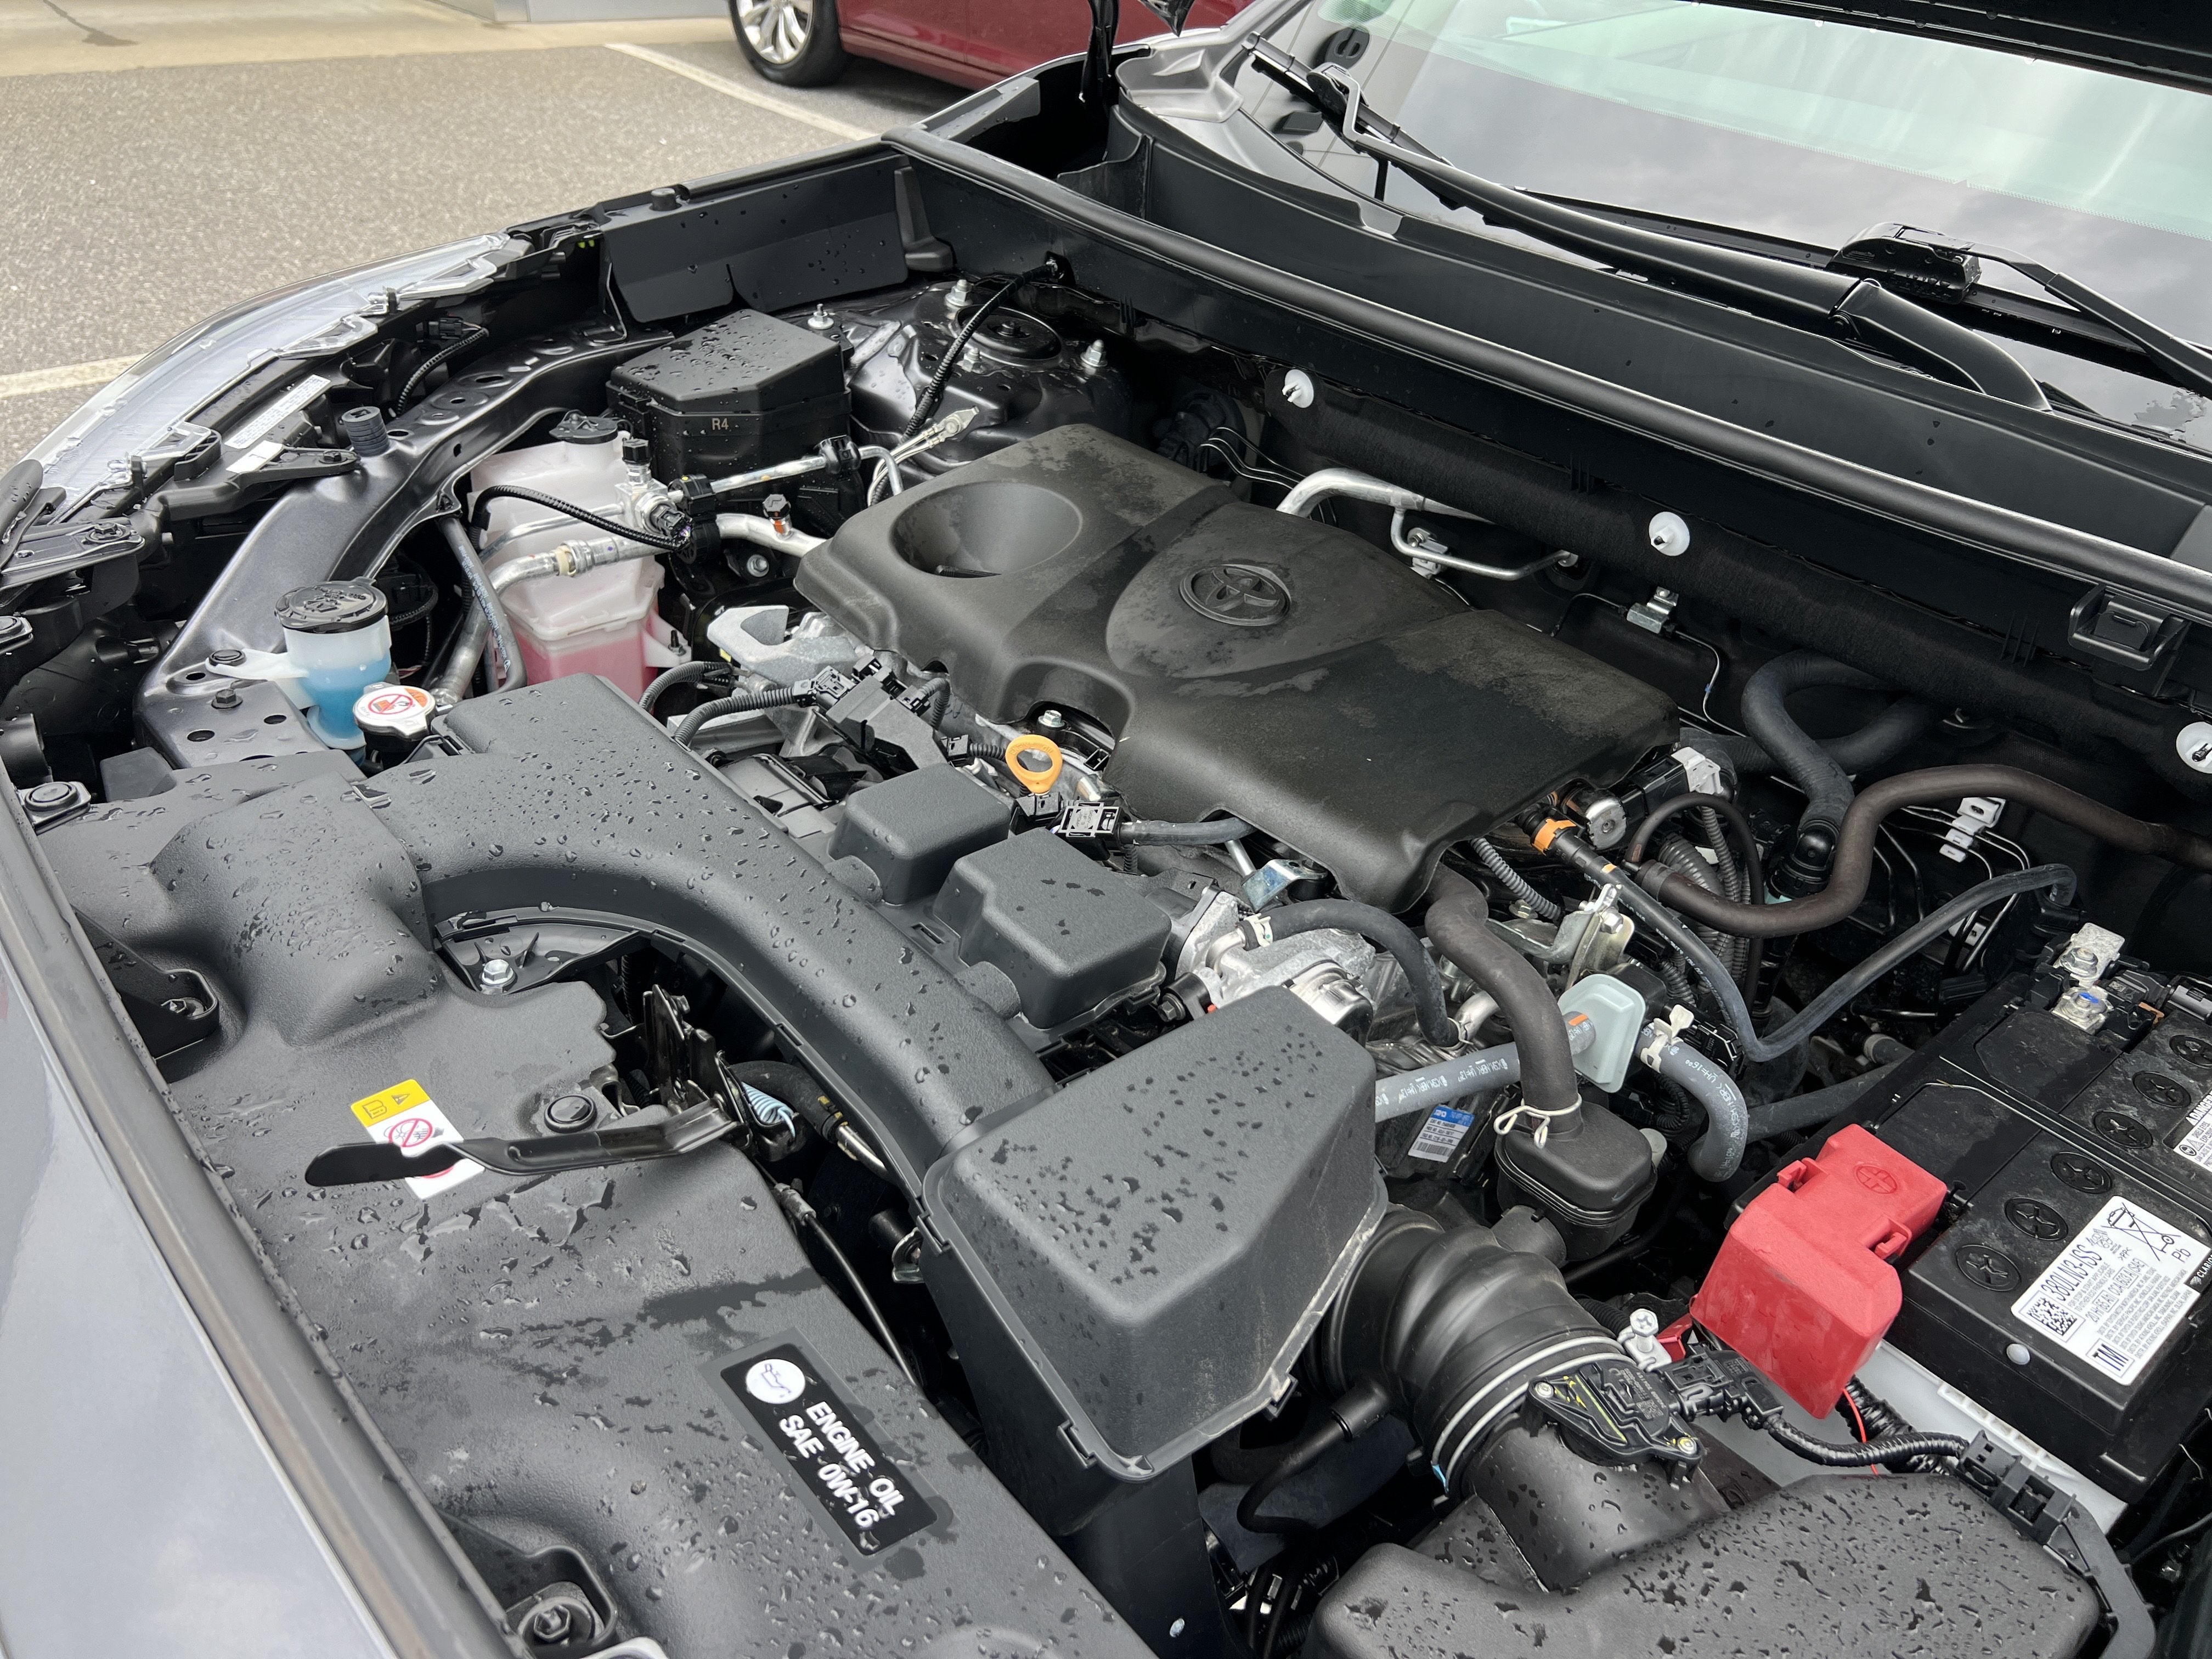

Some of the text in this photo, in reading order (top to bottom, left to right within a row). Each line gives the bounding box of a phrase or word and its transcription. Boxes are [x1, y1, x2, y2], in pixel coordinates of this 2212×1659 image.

[712, 417, 729, 430] R4
[2170, 1245, 2192, 1263] Pb
[2039, 1242, 2104, 1303] 380LN3-ISS
[2121, 1268, 2136, 1278] A
[2196, 1254, 2212, 1278] CLARIO
[2114, 1272, 2133, 1286] 603
[2106, 1280, 2126, 1296] CCA
[2094, 1298, 2111, 1311] 65
[2100, 1291, 2117, 1305] Ah
[2084, 1310, 2101, 1323] 20
[2091, 1341, 2130, 1374] TM
[806, 1401, 905, 1518] ENGINE OIL
[778, 1414, 881, 1528] SAE 0W-16
